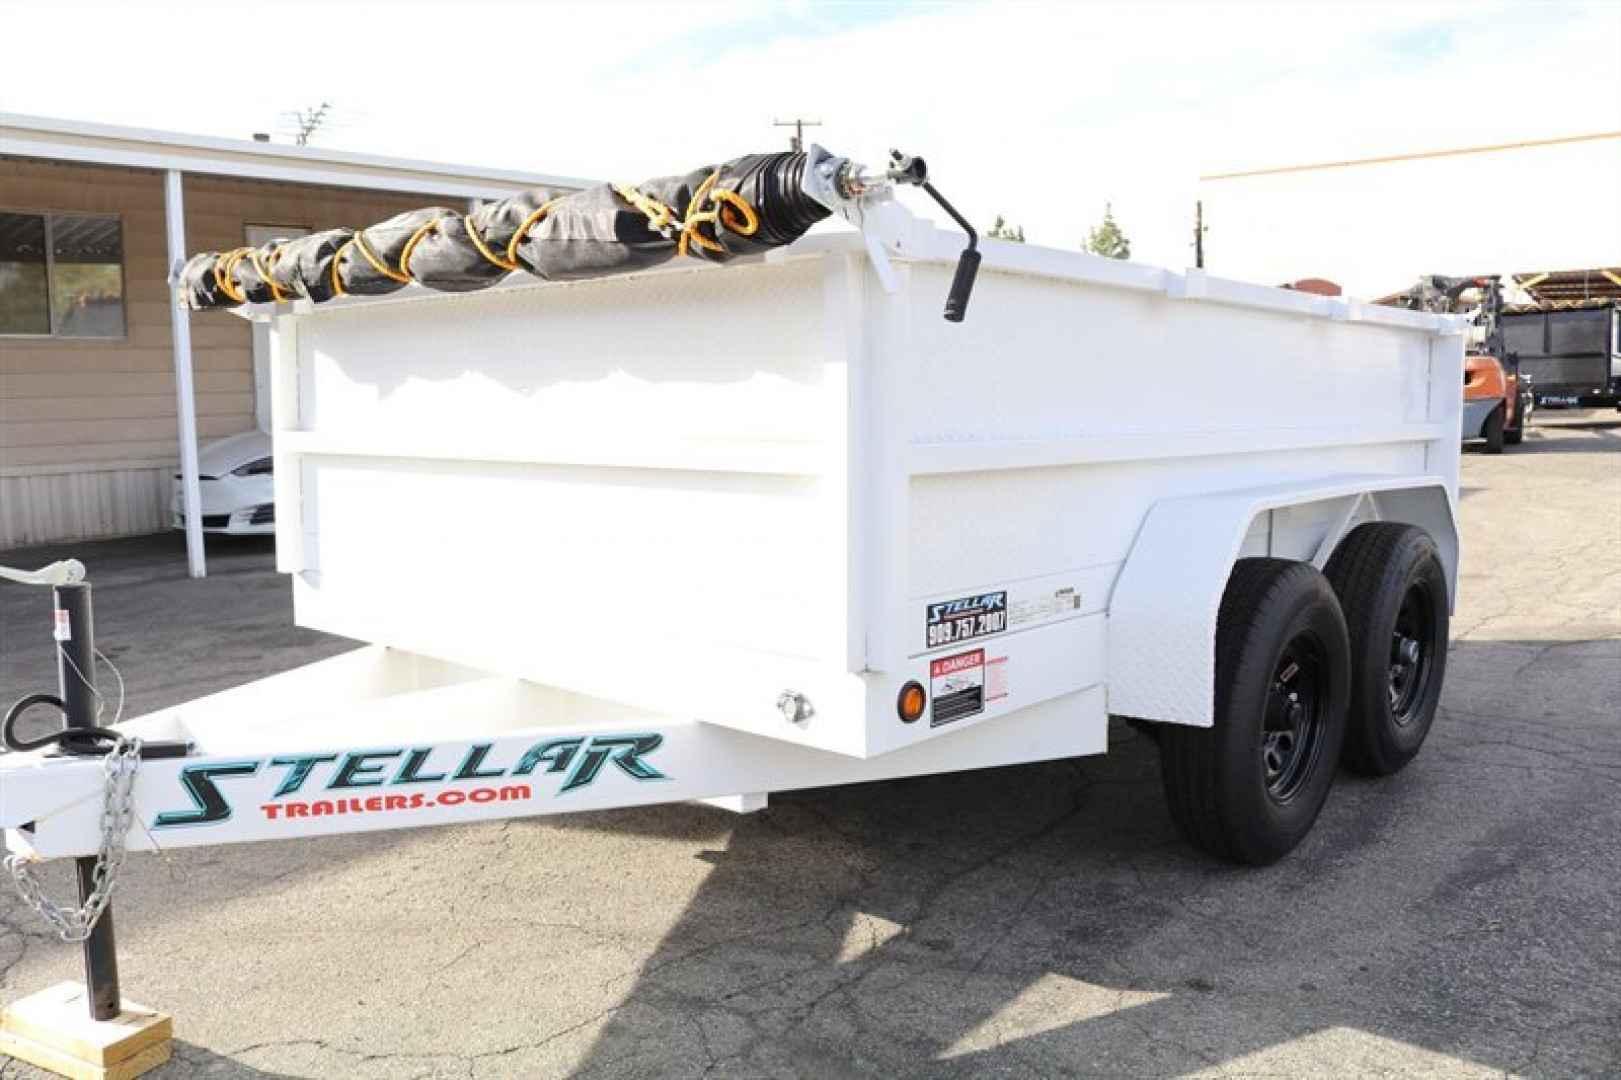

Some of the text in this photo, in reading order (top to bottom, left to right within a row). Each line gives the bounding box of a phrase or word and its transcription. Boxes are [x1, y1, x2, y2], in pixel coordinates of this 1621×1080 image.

[928, 592, 1004, 623] STELLAR
[941, 651, 981, 674] DANGER
[150, 732, 676, 830] STELLAR
